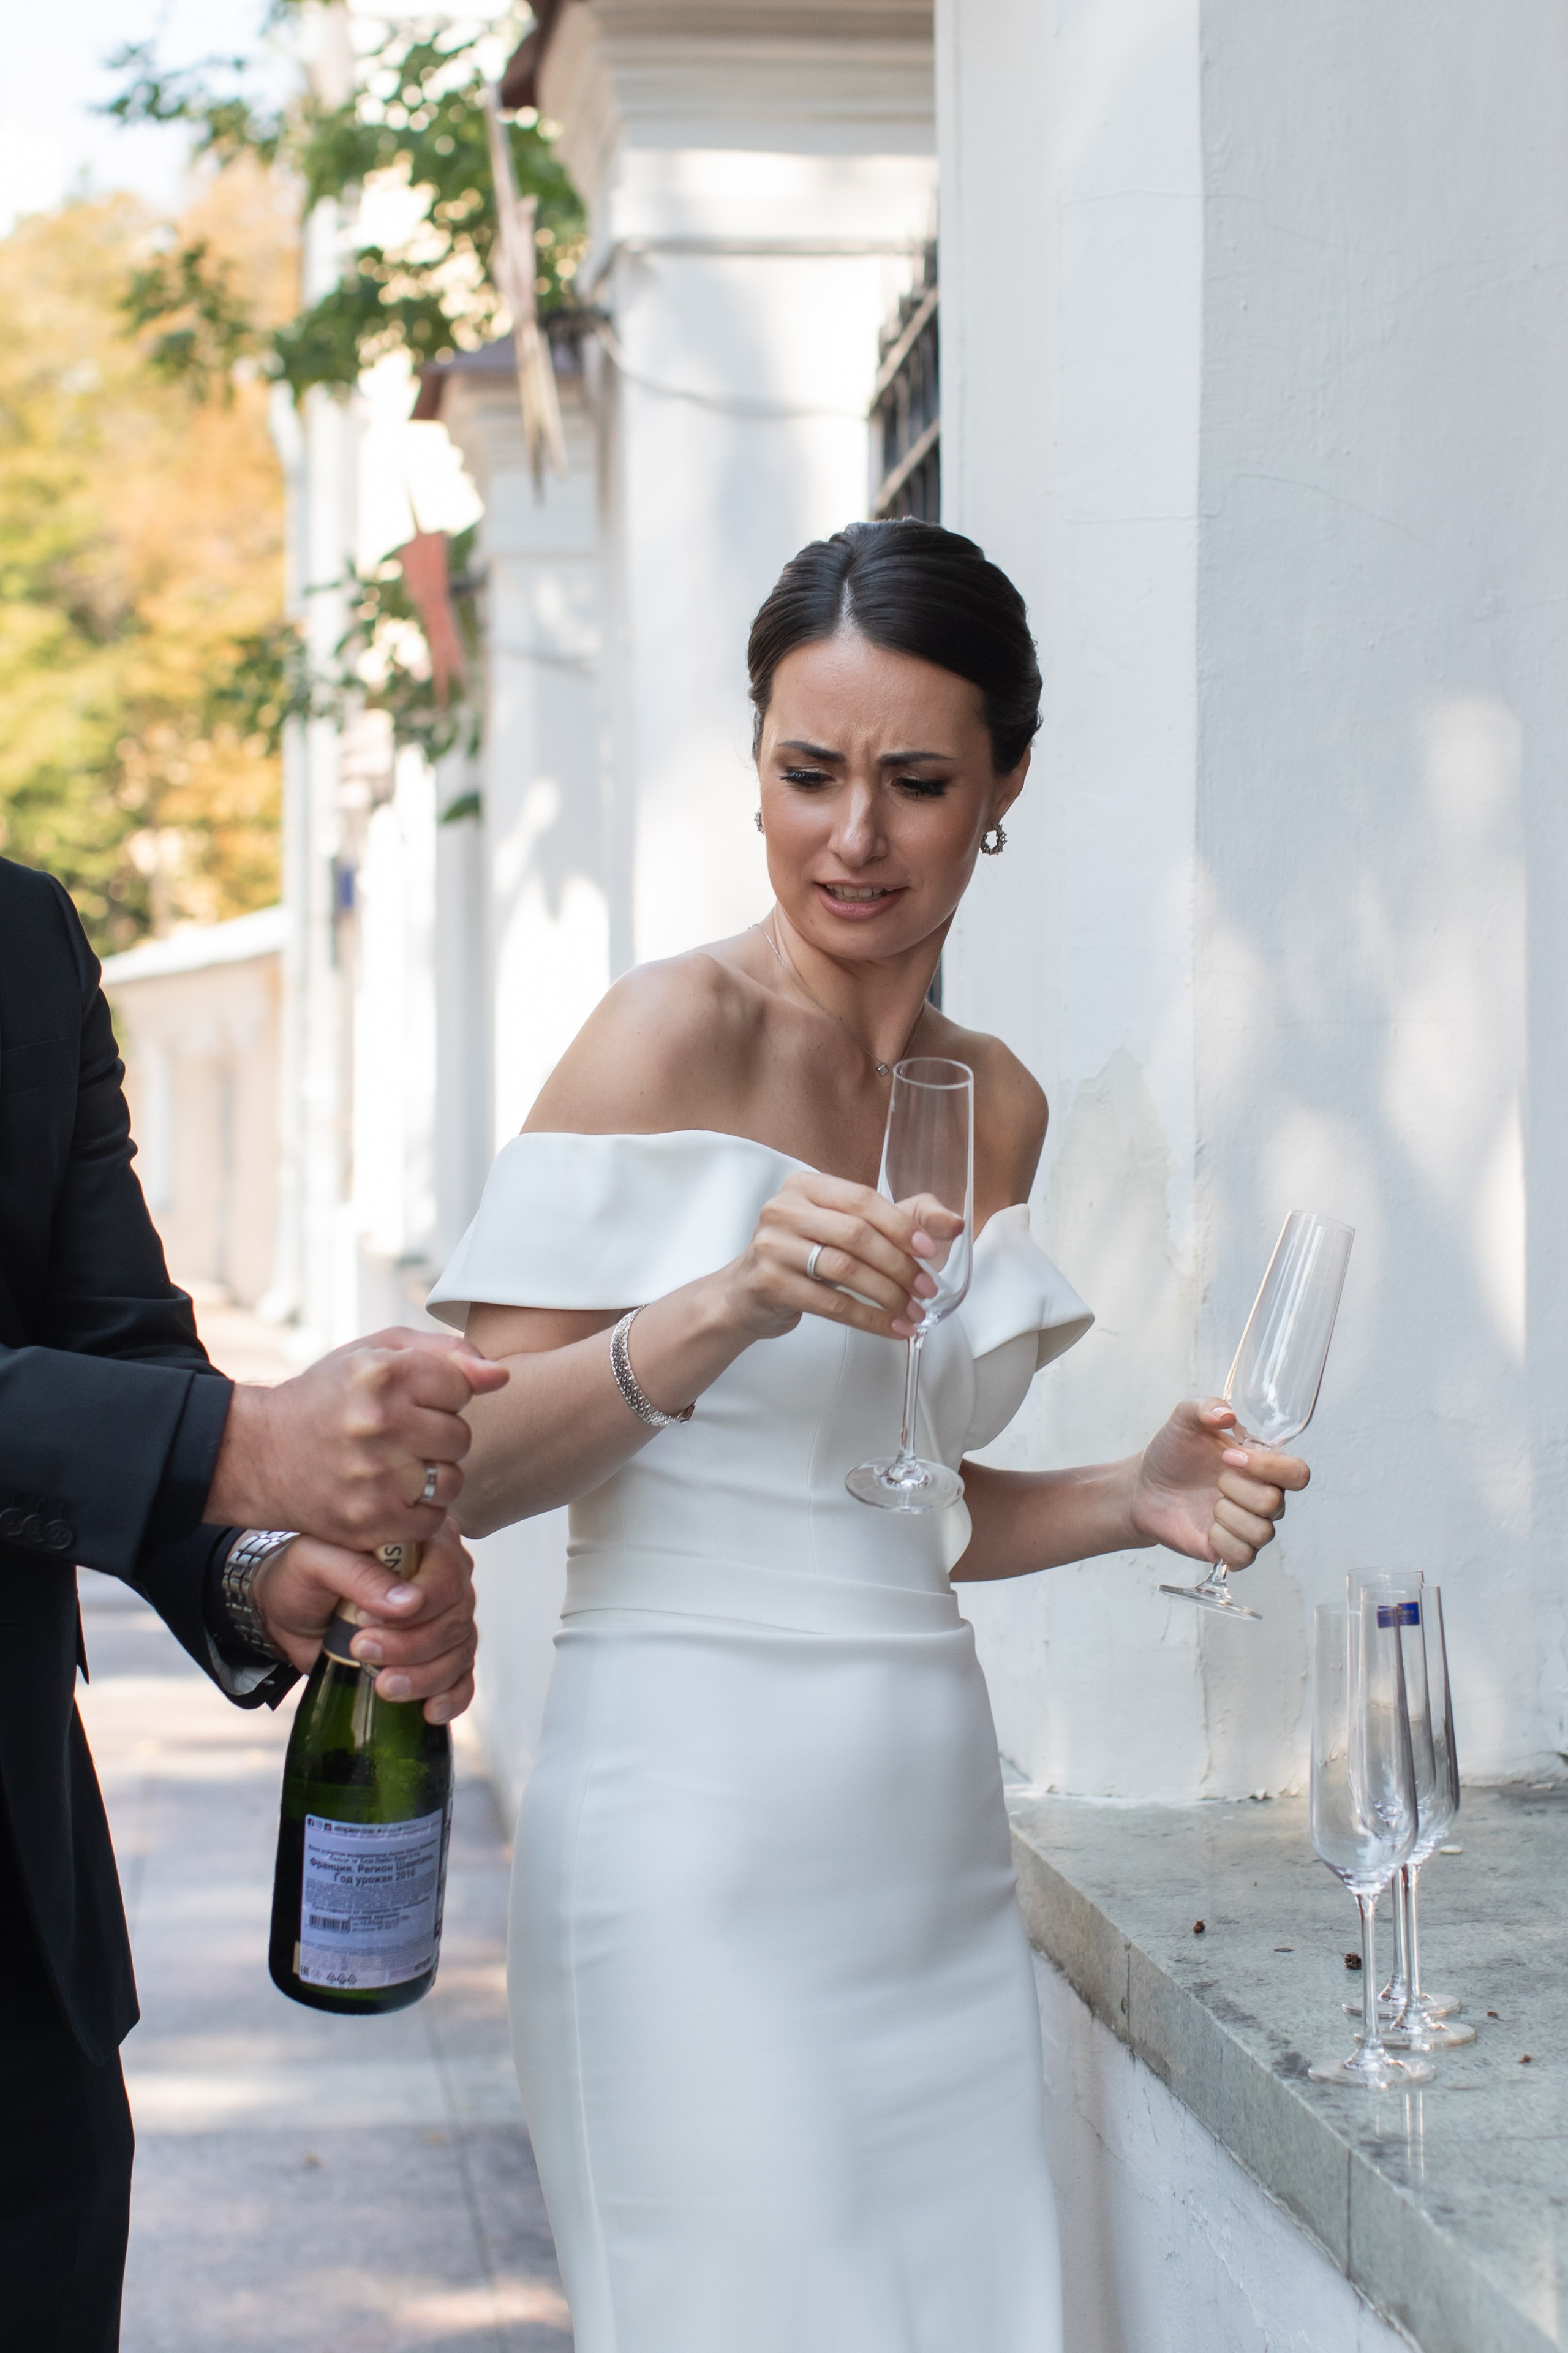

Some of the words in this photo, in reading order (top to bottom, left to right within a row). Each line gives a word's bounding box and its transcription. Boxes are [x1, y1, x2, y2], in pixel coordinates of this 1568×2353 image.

[357, 1864, 393, 1873] Регион
[334, 1871, 353, 1884] Год
[356, 1874, 393, 1886] урожая
[395, 1868, 416, 1881] 2016
